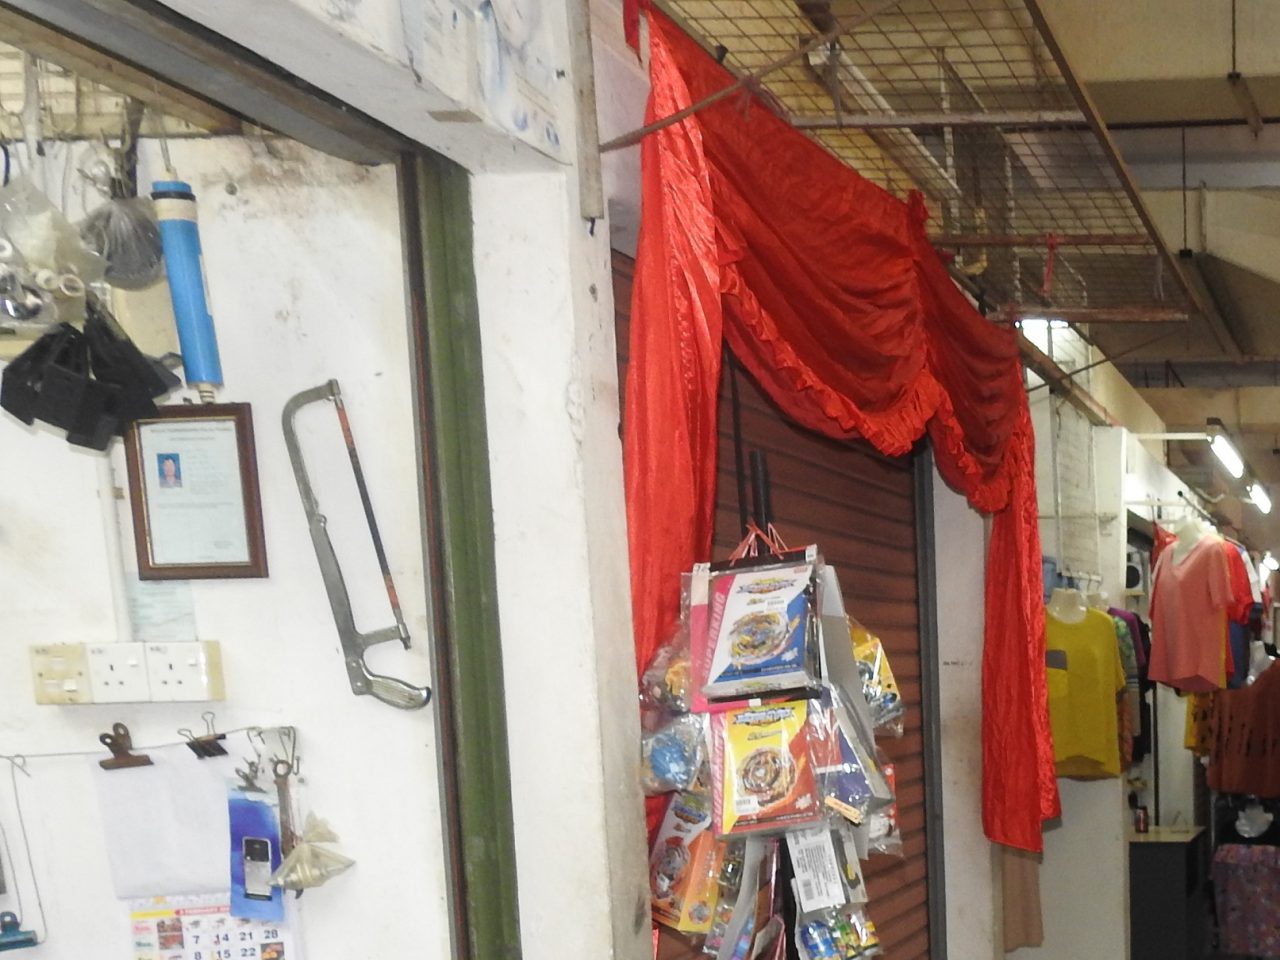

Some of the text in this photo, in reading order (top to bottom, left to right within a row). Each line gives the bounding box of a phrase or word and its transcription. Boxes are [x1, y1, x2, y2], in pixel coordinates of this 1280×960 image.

[194, 935, 200, 944] 7
[239, 932, 253, 941] 21
[264, 930, 278, 939] 28
[194, 952, 201, 960] 8
[241, 948, 256, 957] 22
